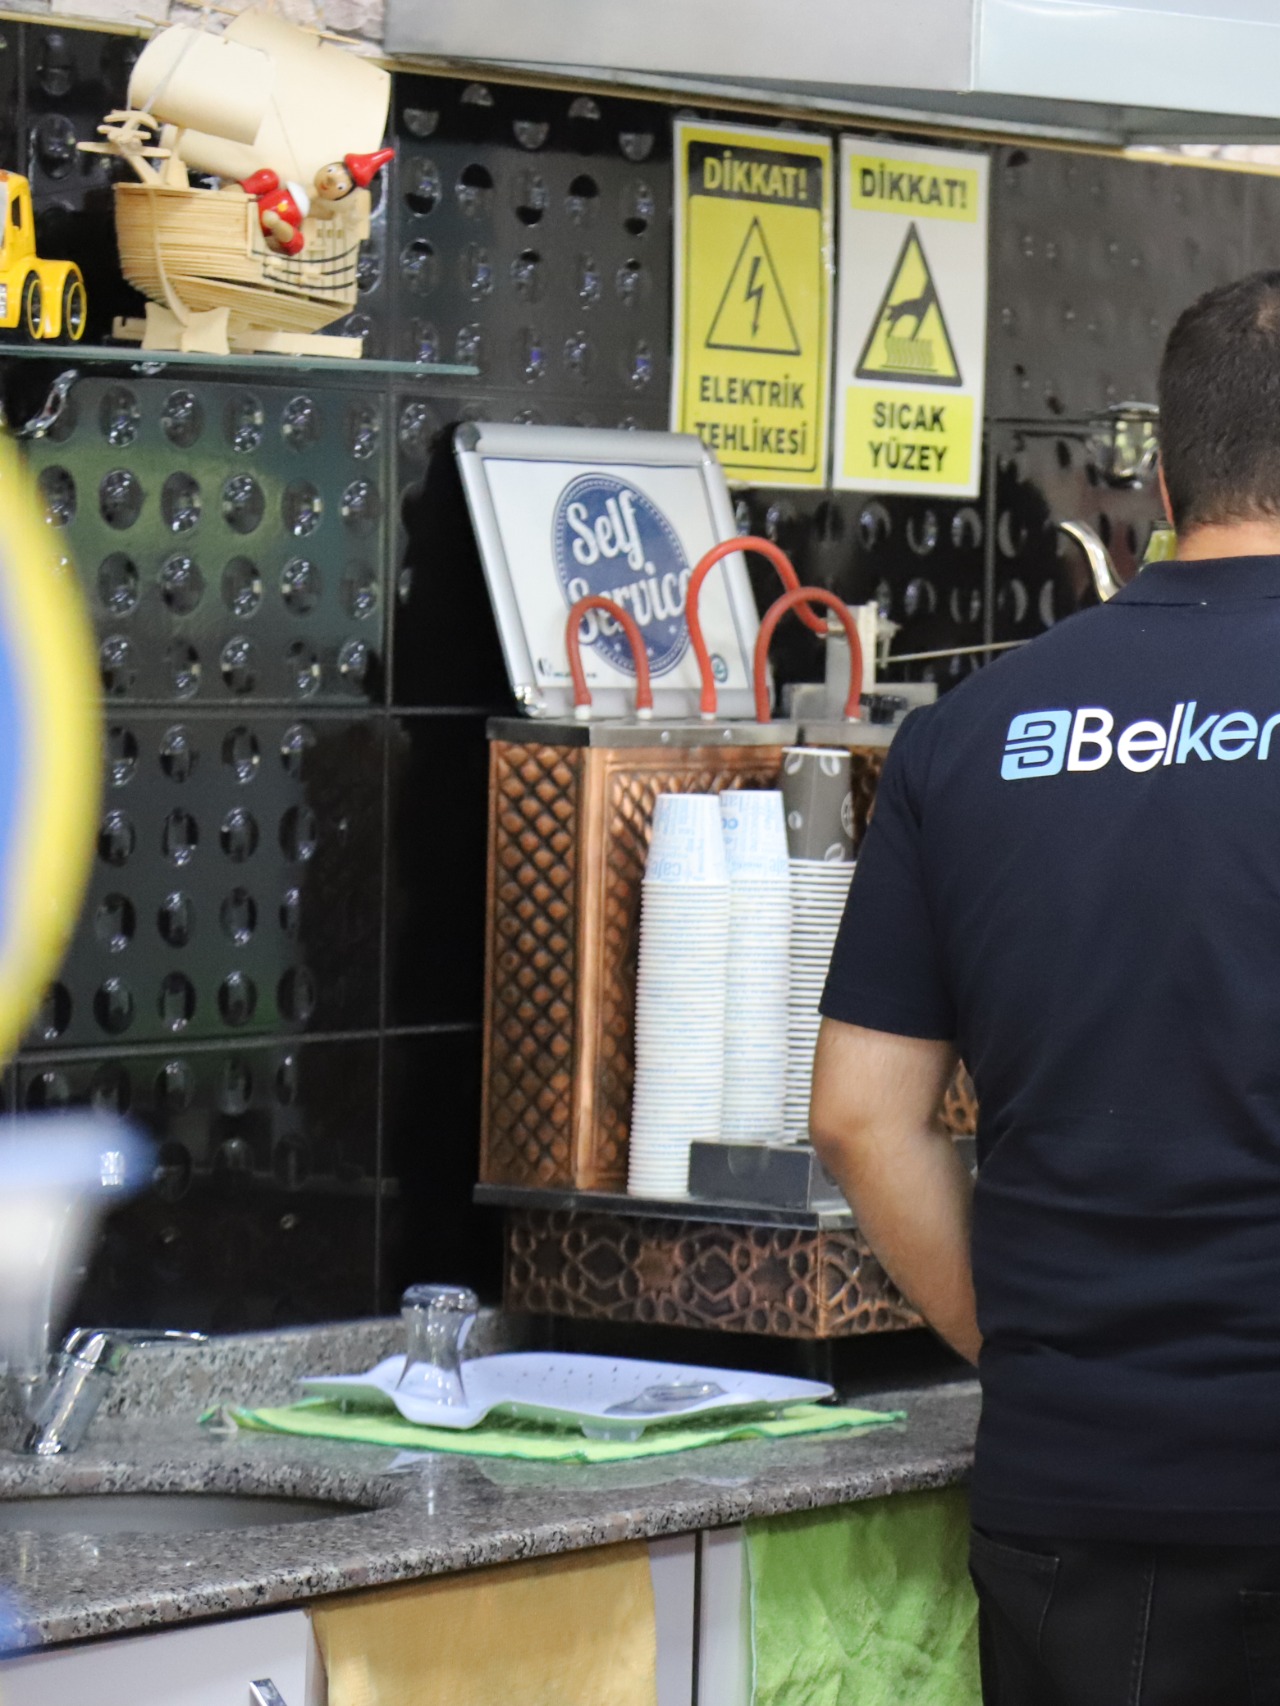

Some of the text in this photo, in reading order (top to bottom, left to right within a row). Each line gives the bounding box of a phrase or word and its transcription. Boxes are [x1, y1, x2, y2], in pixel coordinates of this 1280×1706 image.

[703, 150, 808, 200] DİKKAT!
[860, 162, 968, 209] DİKKAT!
[699, 374, 805, 409] ELEKTRİK
[694, 417, 808, 456] TEHLİKESİ
[872, 402, 946, 433] SICAK
[868, 437, 948, 473] YÜZEY
[566, 489, 639, 572] Self
